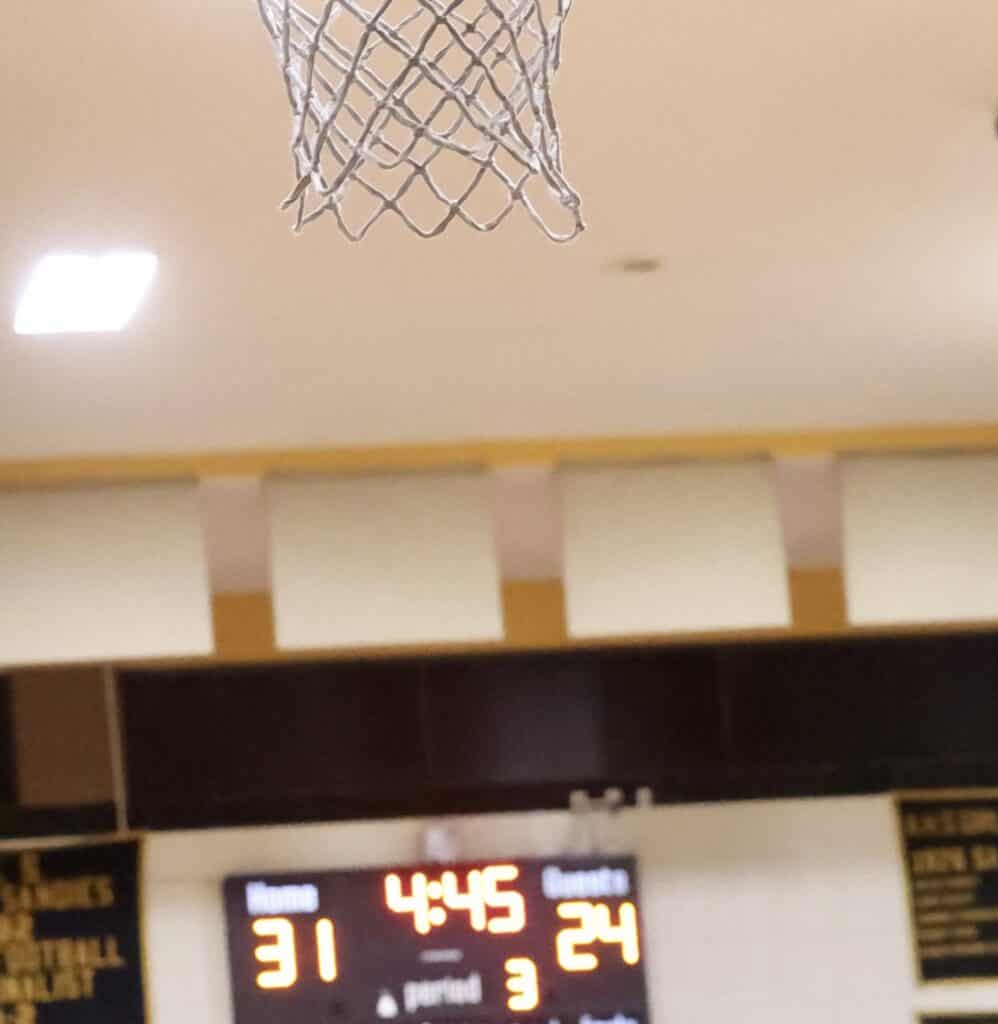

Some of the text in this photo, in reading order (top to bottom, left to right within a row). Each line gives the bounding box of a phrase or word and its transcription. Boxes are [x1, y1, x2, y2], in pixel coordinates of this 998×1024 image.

[384, 864, 526, 934] 4:45
[252, 916, 338, 989] 31
[555, 901, 640, 971] 24
[504, 957, 539, 1012] 3
